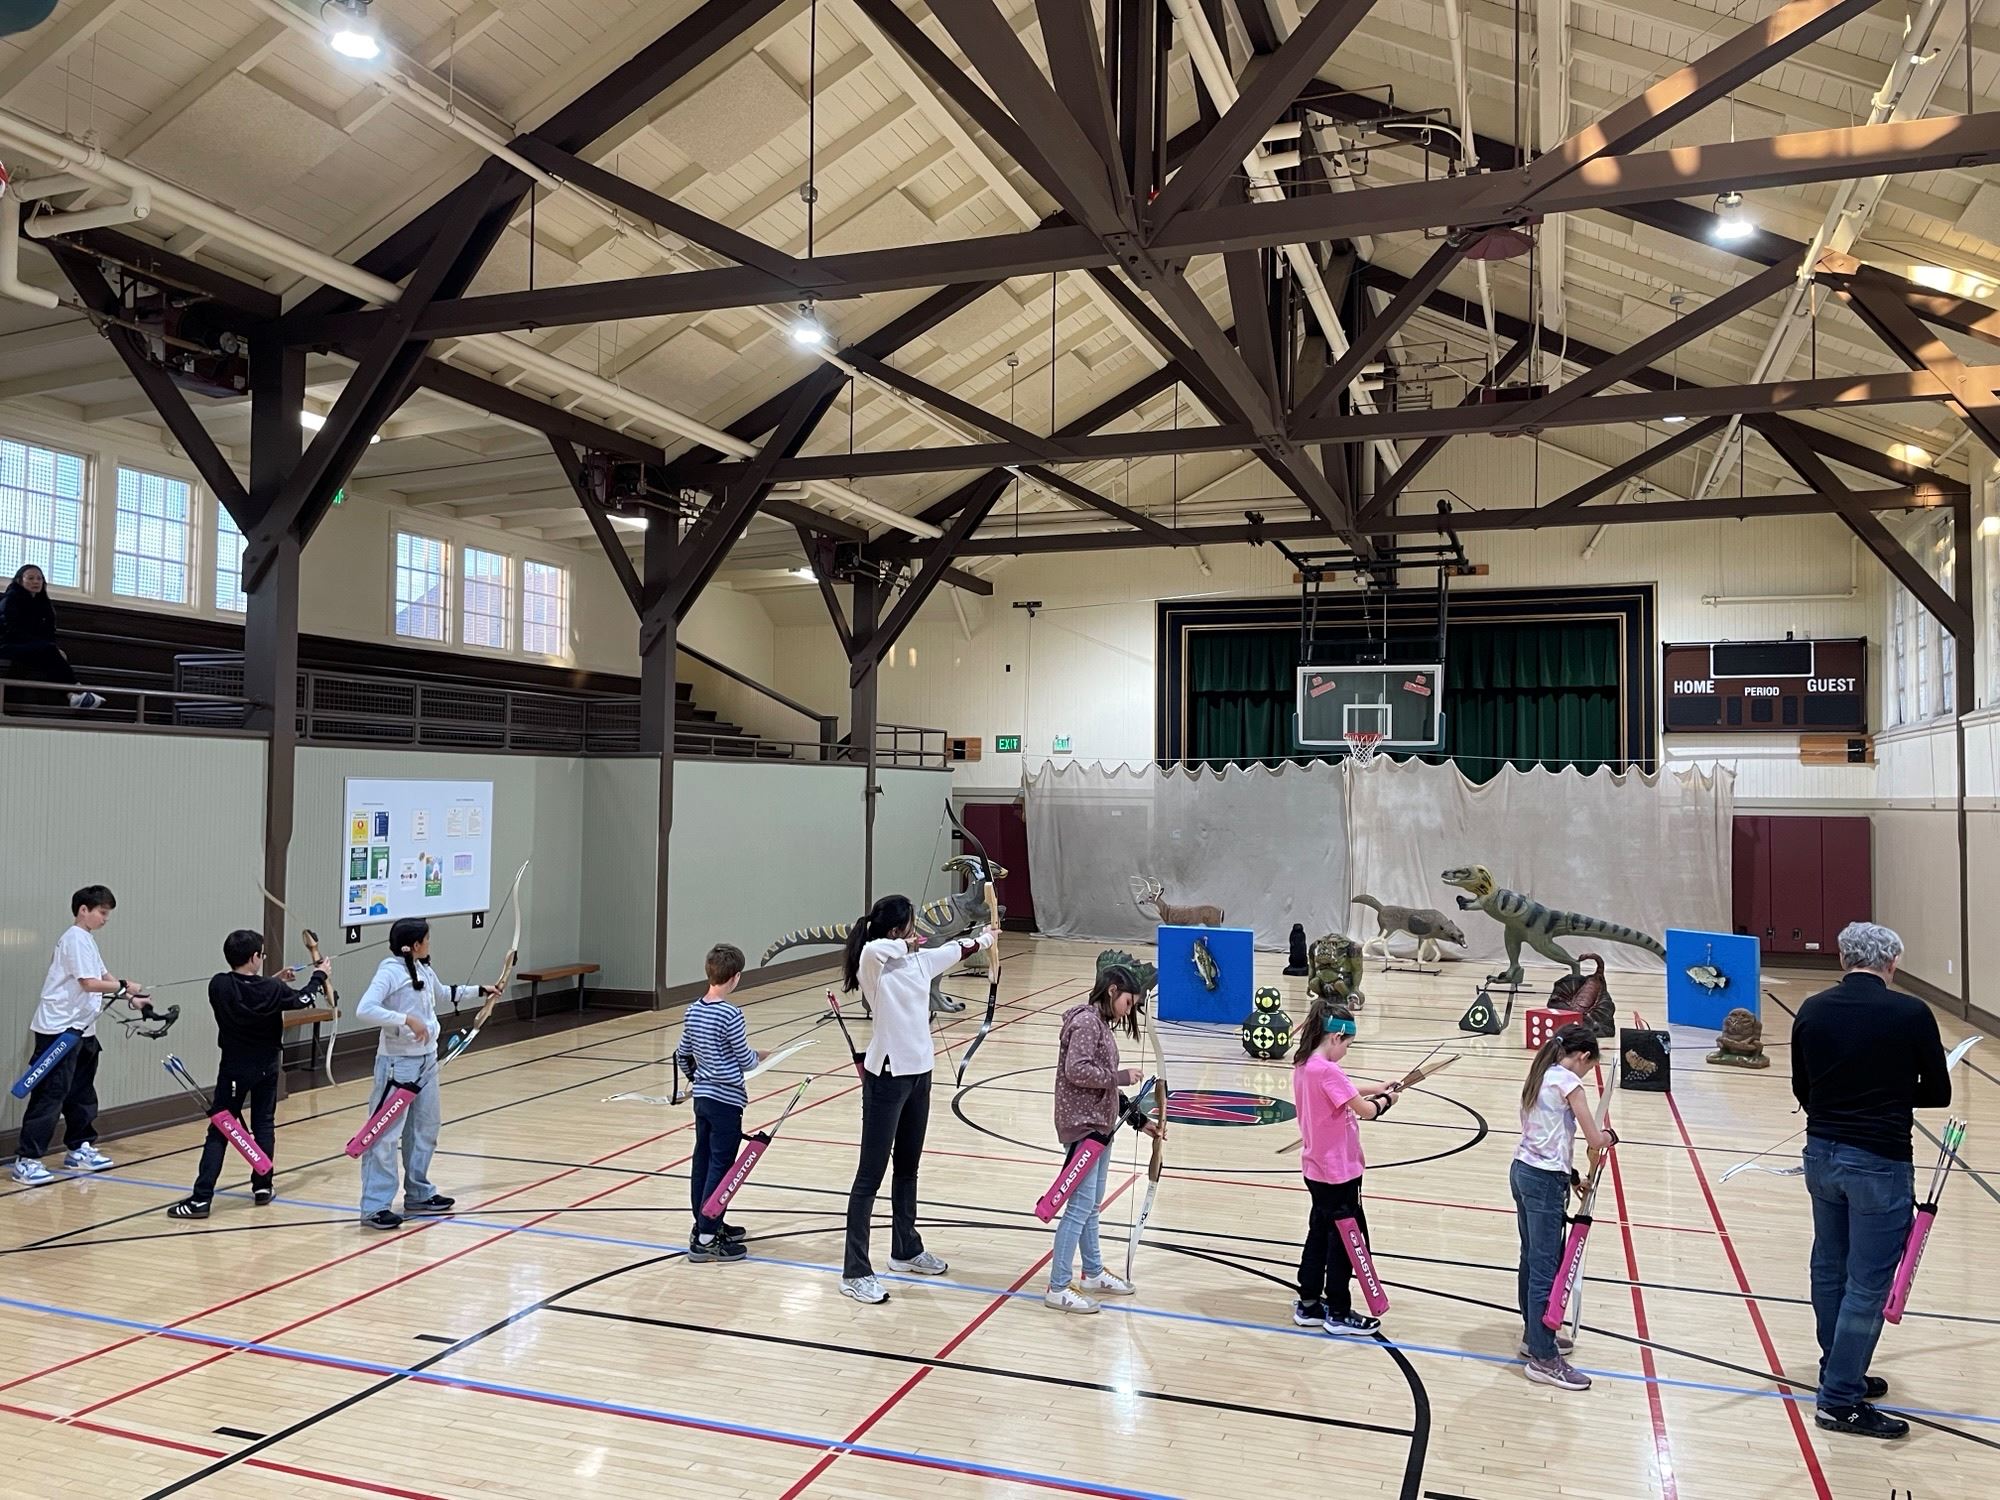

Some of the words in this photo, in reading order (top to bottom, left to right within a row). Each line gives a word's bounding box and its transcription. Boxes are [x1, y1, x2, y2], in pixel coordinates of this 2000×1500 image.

[1674, 680, 1715, 694] HOME
[1744, 687, 1780, 697] PERIOD
[1807, 678, 1856, 693] GUEST
[999, 738, 1018, 750] EXIT
[371, 1098, 404, 1135] EASTON
[231, 1129, 261, 1162] EASTON
[728, 1151, 757, 1192] EASTON
[1060, 1149, 1092, 1194] EASTON
[1354, 1247, 1380, 1298] EASTON
[1565, 1237, 1585, 1291] EASTON
